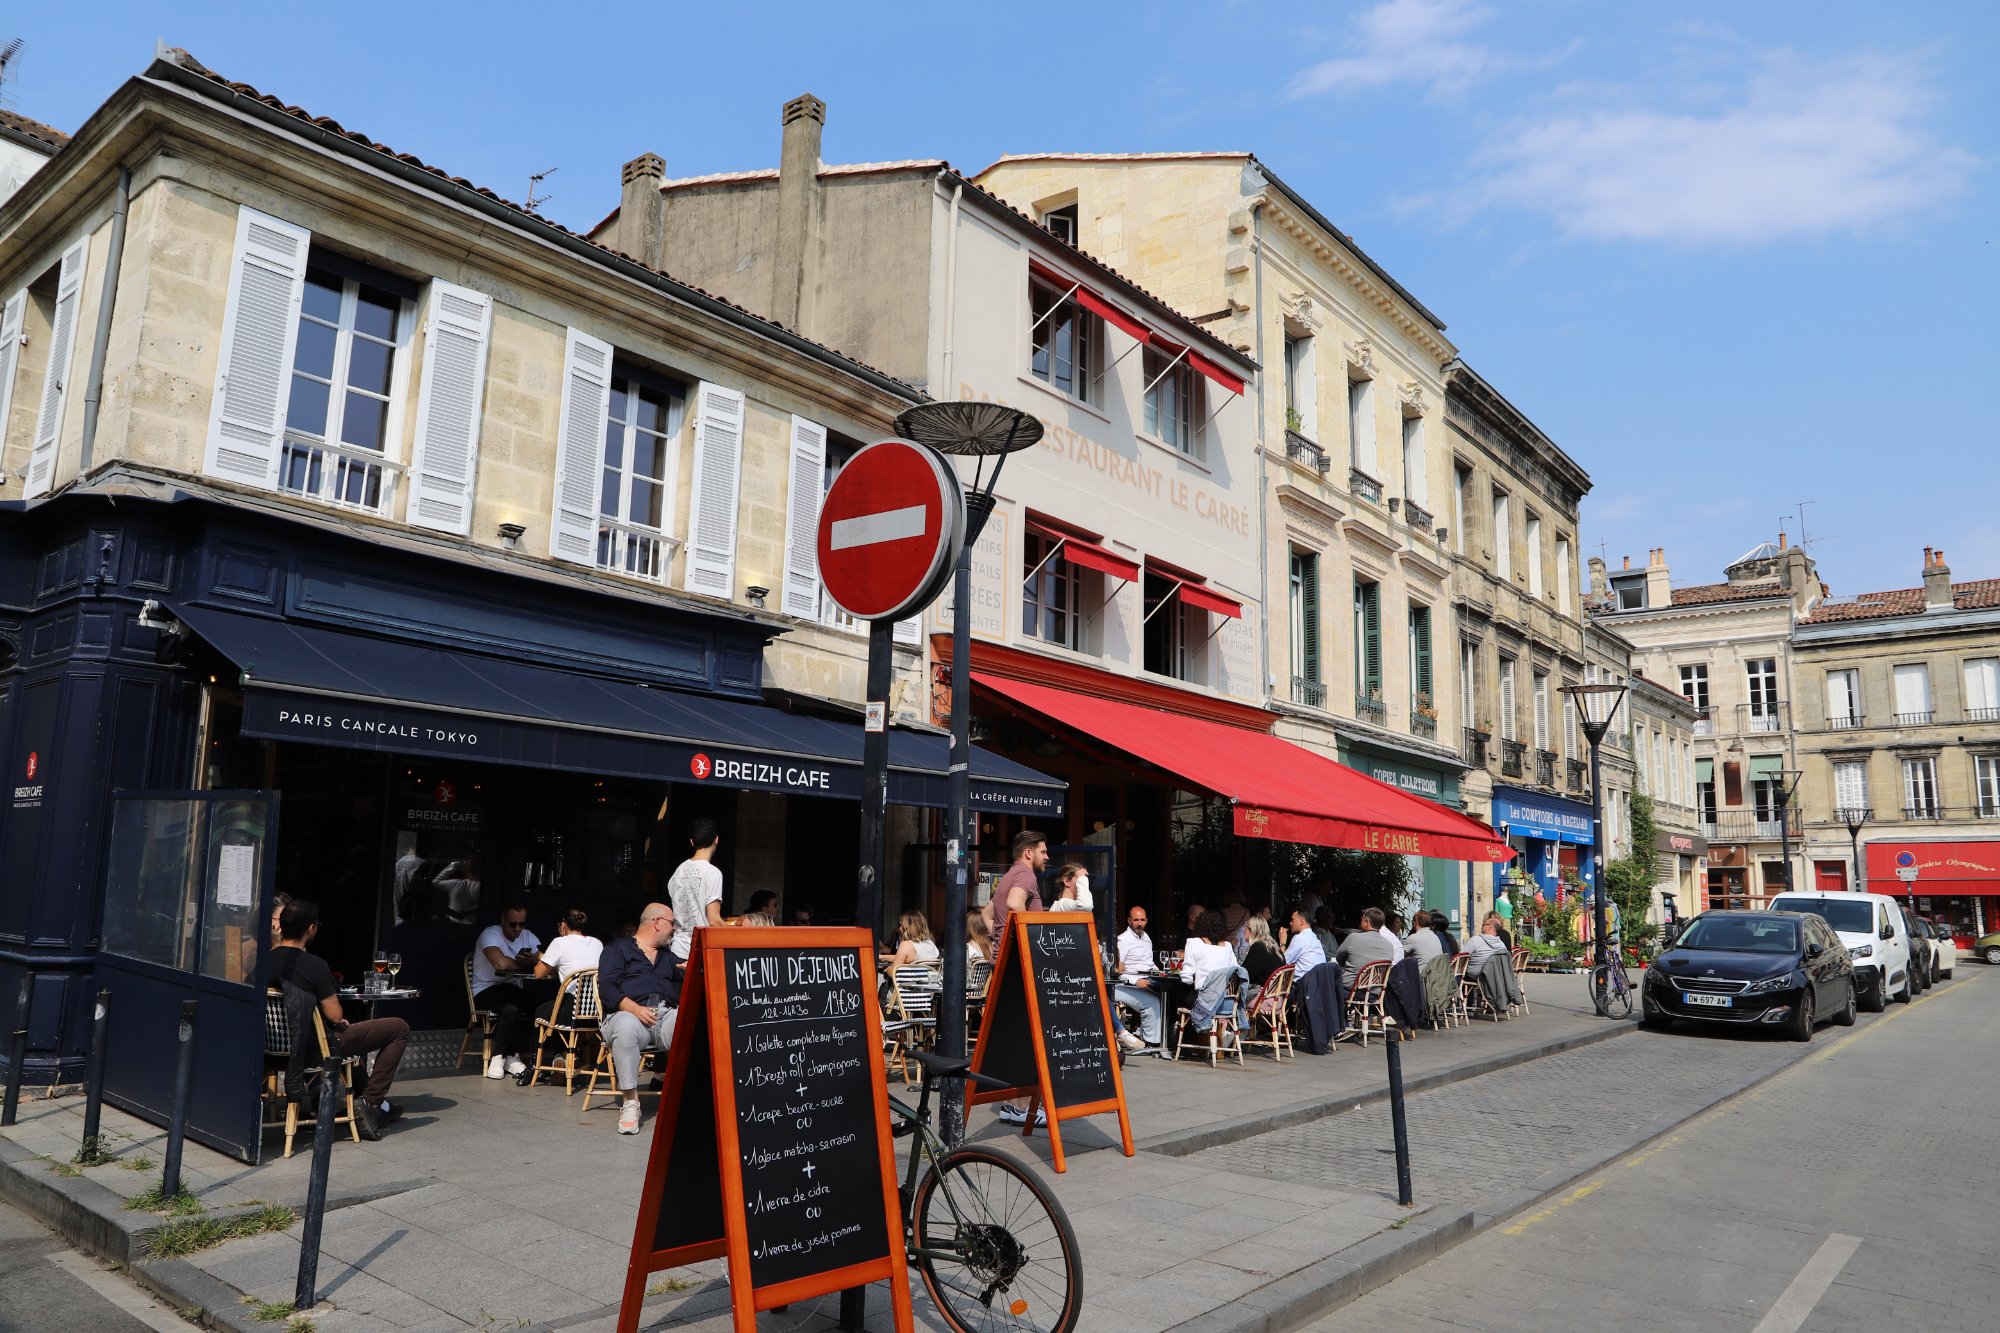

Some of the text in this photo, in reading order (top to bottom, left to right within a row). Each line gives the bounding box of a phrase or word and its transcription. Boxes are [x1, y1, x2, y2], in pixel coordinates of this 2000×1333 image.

[1040, 417, 1250, 538] ESTAURANT LE CARRÉ
[279, 711, 477, 745] PARIS CANCALE TOKYO
[714, 759, 830, 789] BREIZH CAFE
[1373, 769, 1437, 794] COPIES CHARTRONS
[970, 791, 980, 801] LA
[1010, 796, 1052, 807] AUTREMENT
[407, 809, 479, 823] BREIZH CAFE
[1510, 804, 1520, 819] Les
[1522, 807, 1554, 825] COMPTOIRS
[1364, 830, 1421, 853] LE CARRÉ
[735, 951, 860, 990] MENU DÉJEUNER
[732, 996, 750, 1009] Du
[745, 1035, 753, 1053] 1
[755, 1034, 785, 1053] Galette
[745, 1058, 861, 1087] 1 Breizh roll champignons
[745, 1104, 757, 1122] 1
[747, 1146, 757, 1166] 1
[757, 1148, 782, 1170] glace
[753, 1181, 831, 1215] 1 verre de cidre
[757, 1239, 769, 1260] 1
[791, 1238, 804, 1251] de
[830, 1224, 861, 1247] pommes
